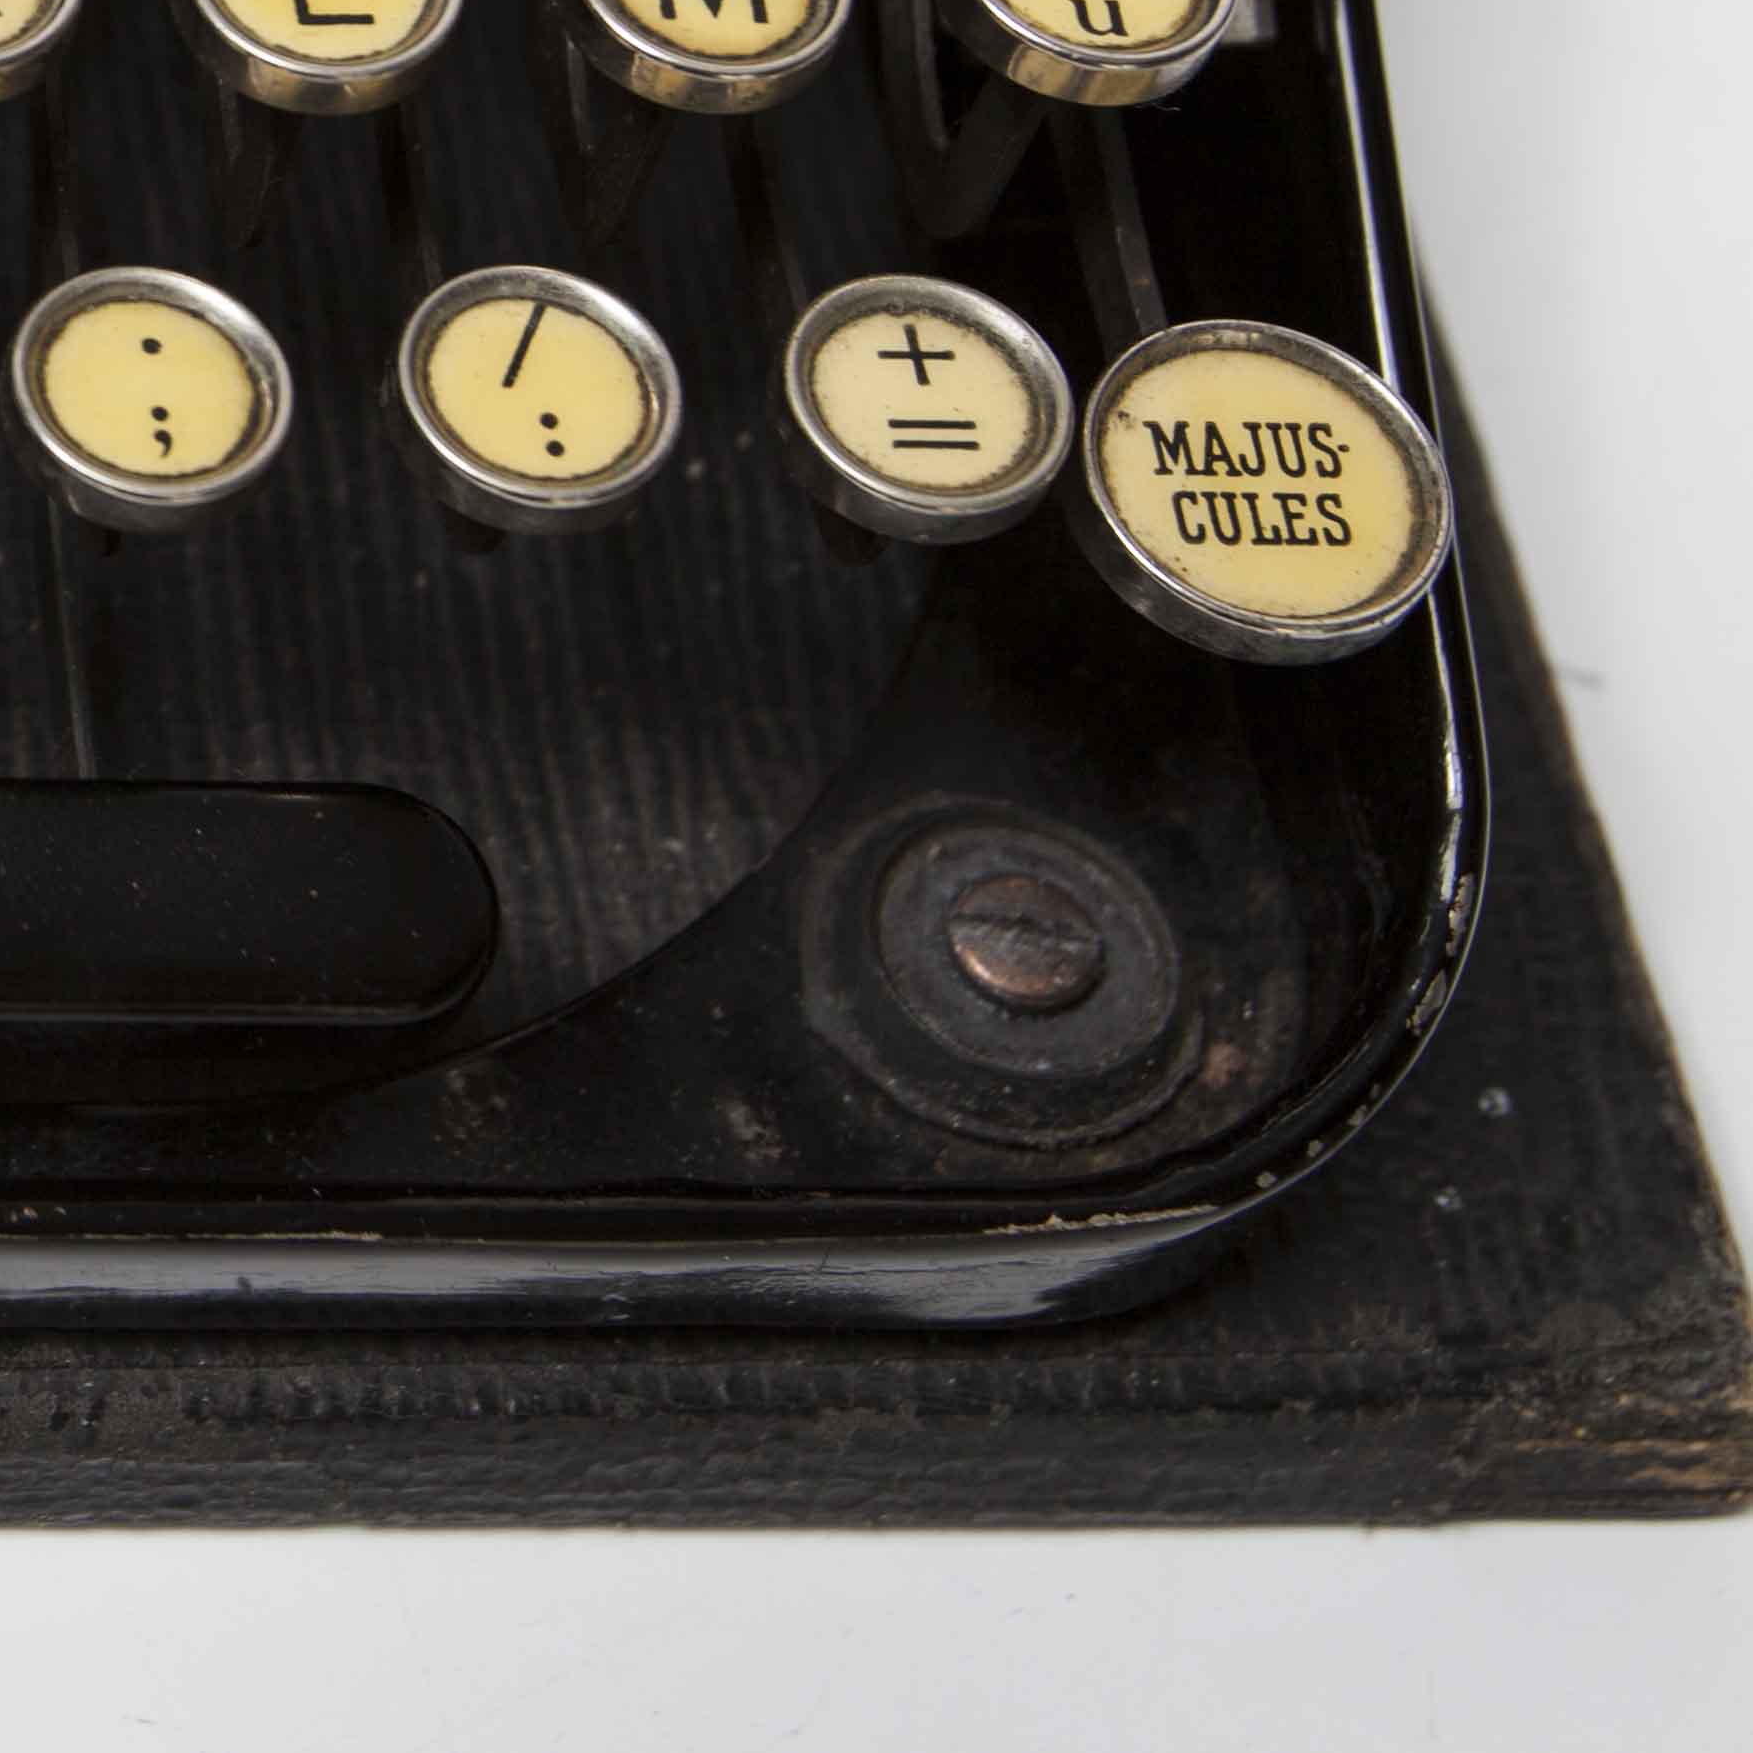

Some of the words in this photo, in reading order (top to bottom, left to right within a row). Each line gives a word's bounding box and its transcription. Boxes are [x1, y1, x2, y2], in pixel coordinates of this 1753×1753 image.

[501, 301, 548, 390] /
[876, 323, 956, 387] +
[539, 411, 566, 458] :
[887, 418, 981, 452] =
[1143, 420, 1350, 479] MAJUS-
[1171, 490, 1353, 547] CULES
